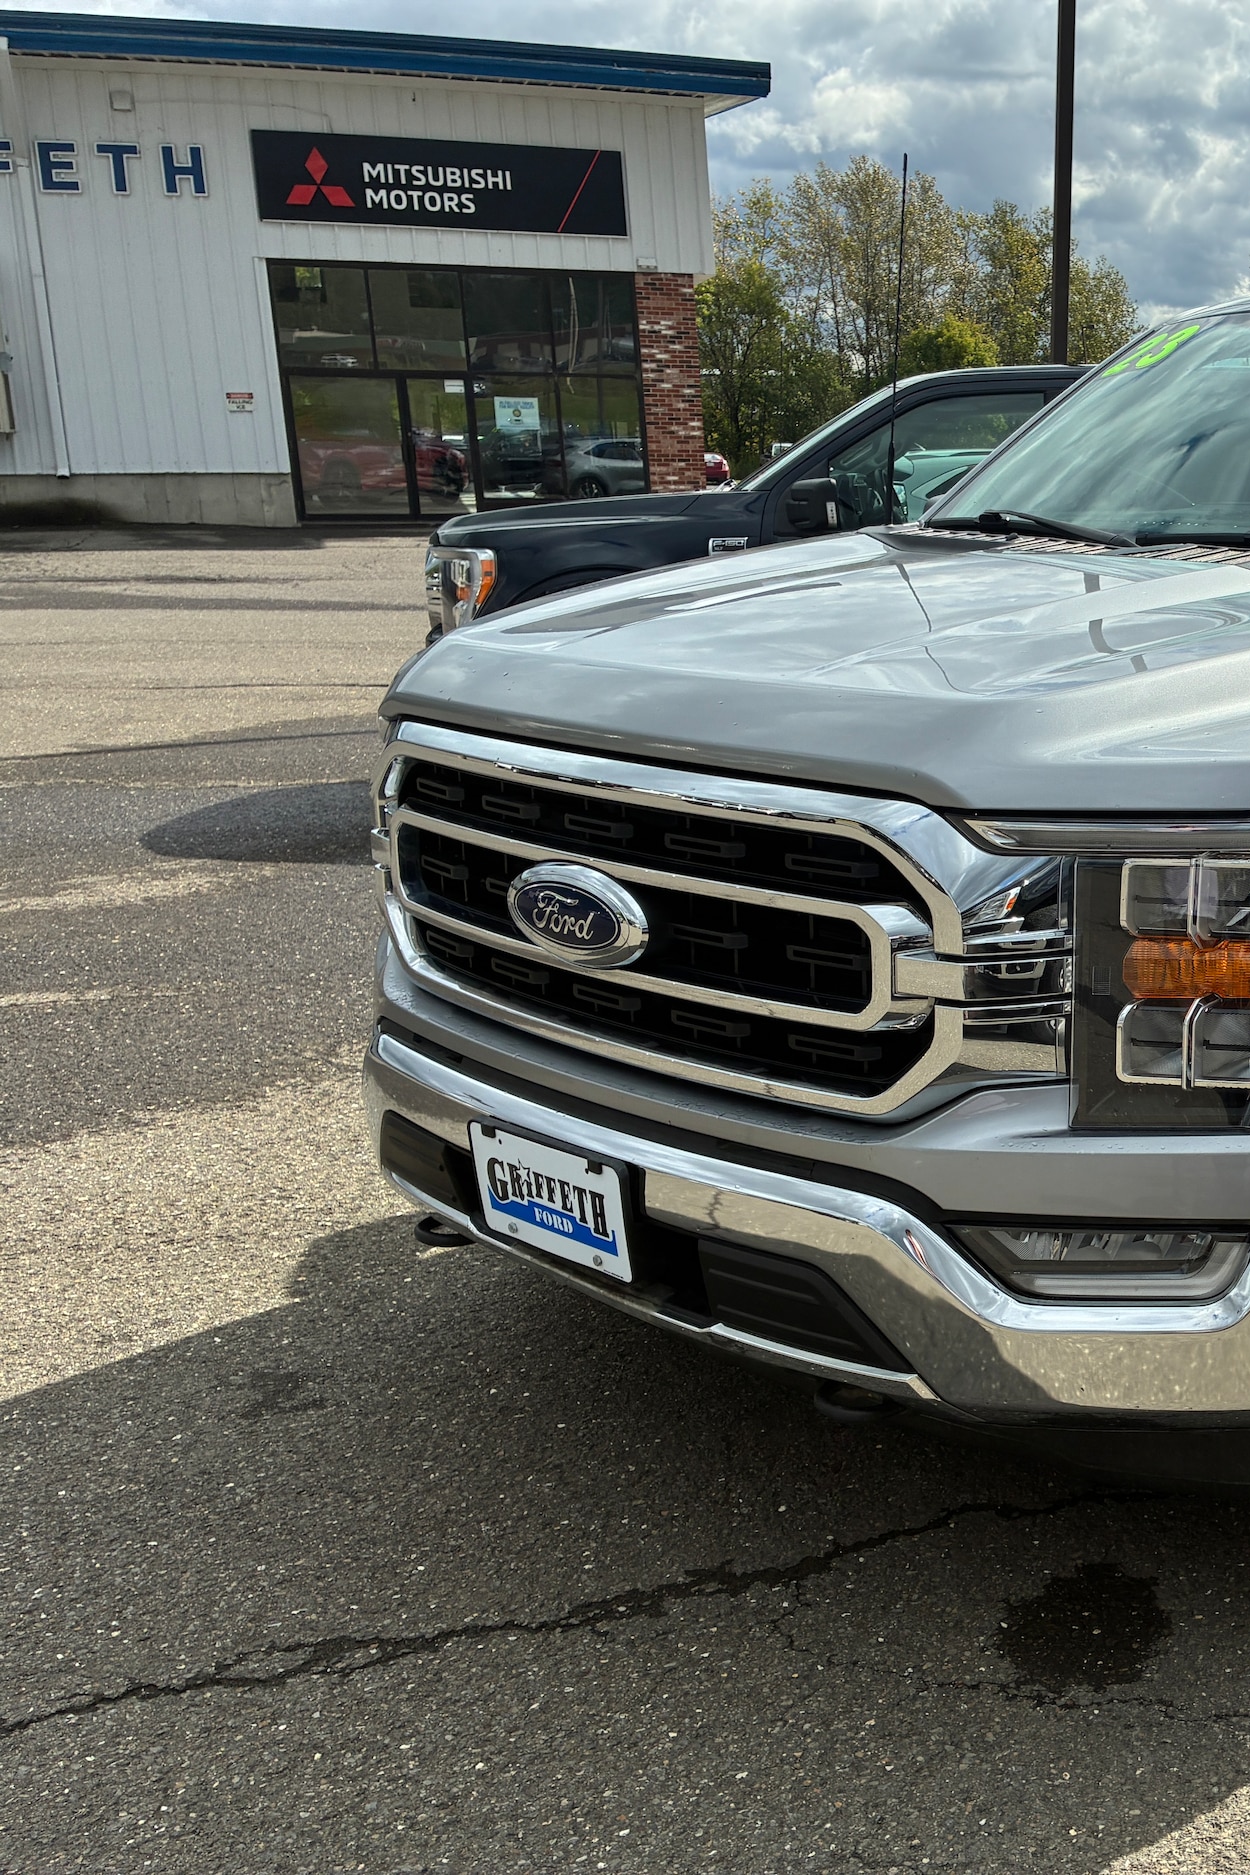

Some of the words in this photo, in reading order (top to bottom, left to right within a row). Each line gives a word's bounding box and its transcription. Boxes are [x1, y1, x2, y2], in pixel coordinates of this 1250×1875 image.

[362, 162, 512, 190] MITSUBISHI
[365, 188, 476, 214] MOTORS
[1101, 325, 1200, 378] 23
[532, 890, 594, 940] Ford
[486, 1157, 610, 1240] GRIFFETH
[533, 1206, 574, 1235] FORD
